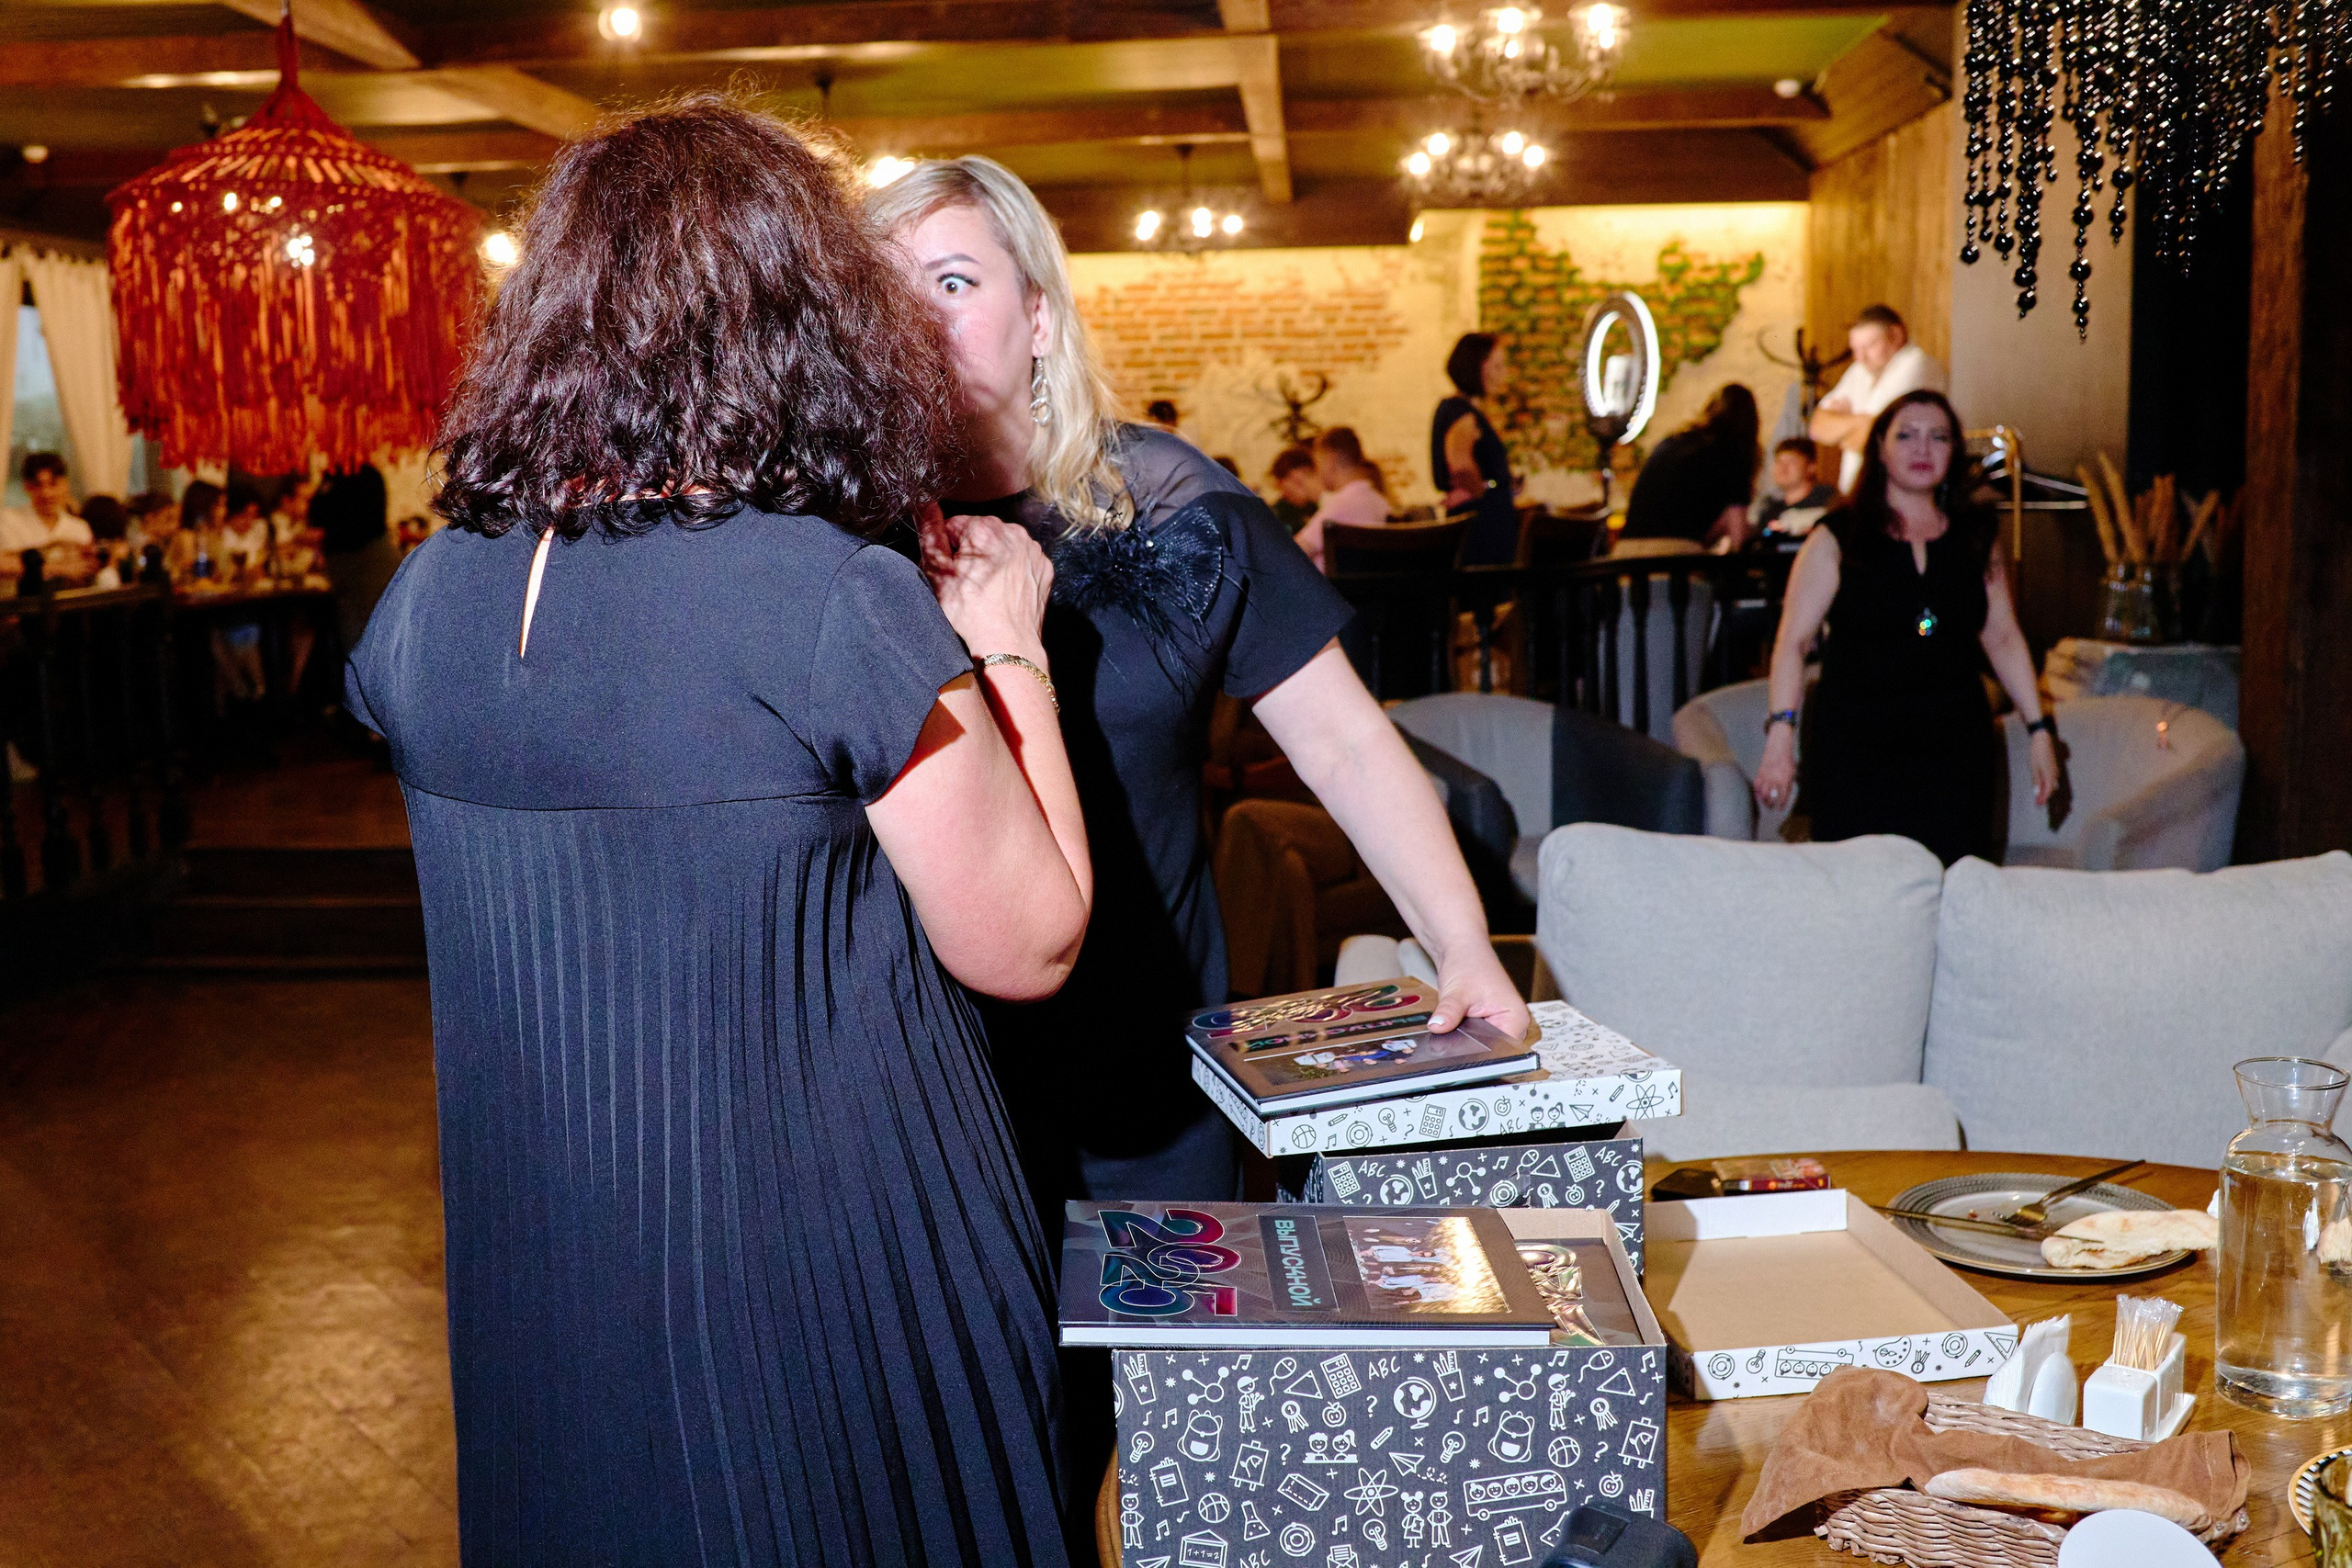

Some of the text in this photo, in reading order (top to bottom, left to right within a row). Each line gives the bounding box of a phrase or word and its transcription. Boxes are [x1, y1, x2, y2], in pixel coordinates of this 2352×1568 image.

[1499, 1116, 1523, 1135] ABC
[1594, 1145, 1623, 1167] ABC
[1357, 1159, 1386, 1178] ABC
[1274, 1219, 1321, 1307] ВЫПУСКНОЙ
[1367, 1355, 1401, 1381] ABC
